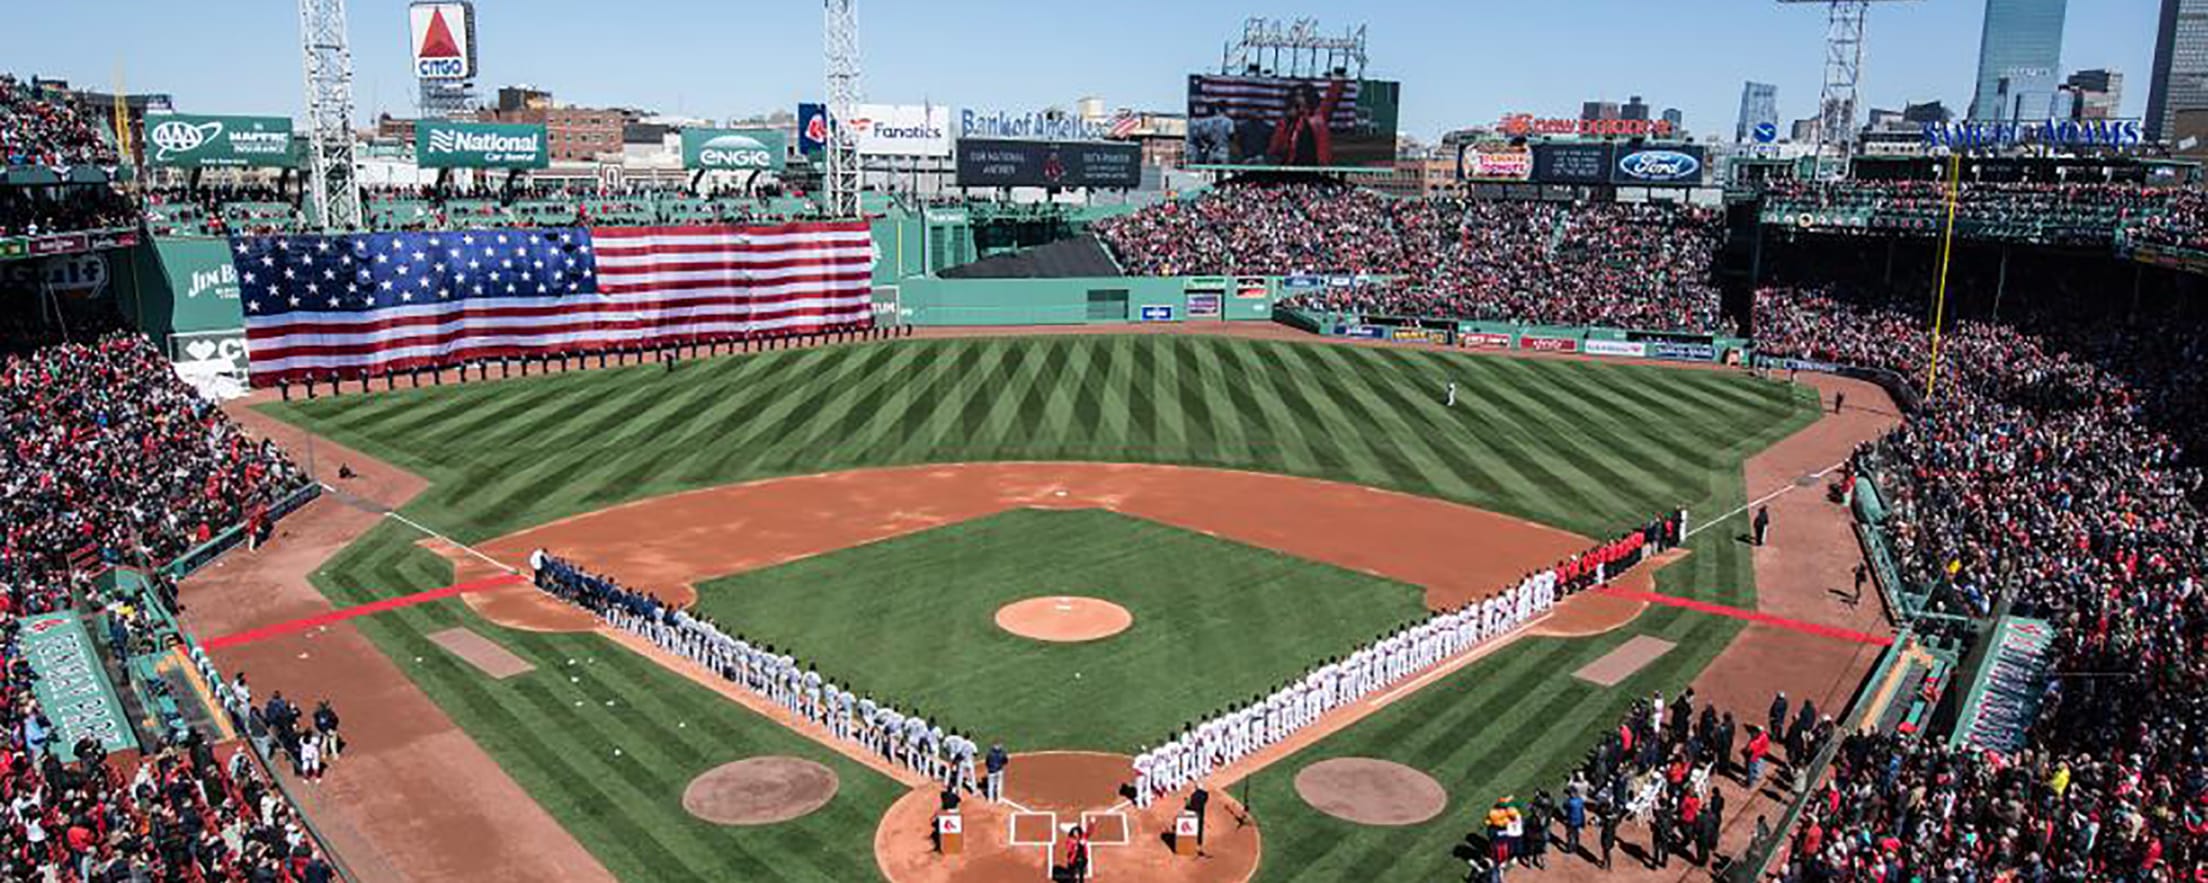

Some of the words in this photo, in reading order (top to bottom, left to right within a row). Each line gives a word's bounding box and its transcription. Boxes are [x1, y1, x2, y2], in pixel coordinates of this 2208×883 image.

[419, 60, 462, 75] CITGO
[874, 122, 942, 139] Fanatics
[962, 109, 1011, 138] Bank
[1011, 112, 1031, 136] of
[160, 124, 200, 148] AAA
[455, 131, 538, 151] National
[1634, 154, 1682, 174] Ford
